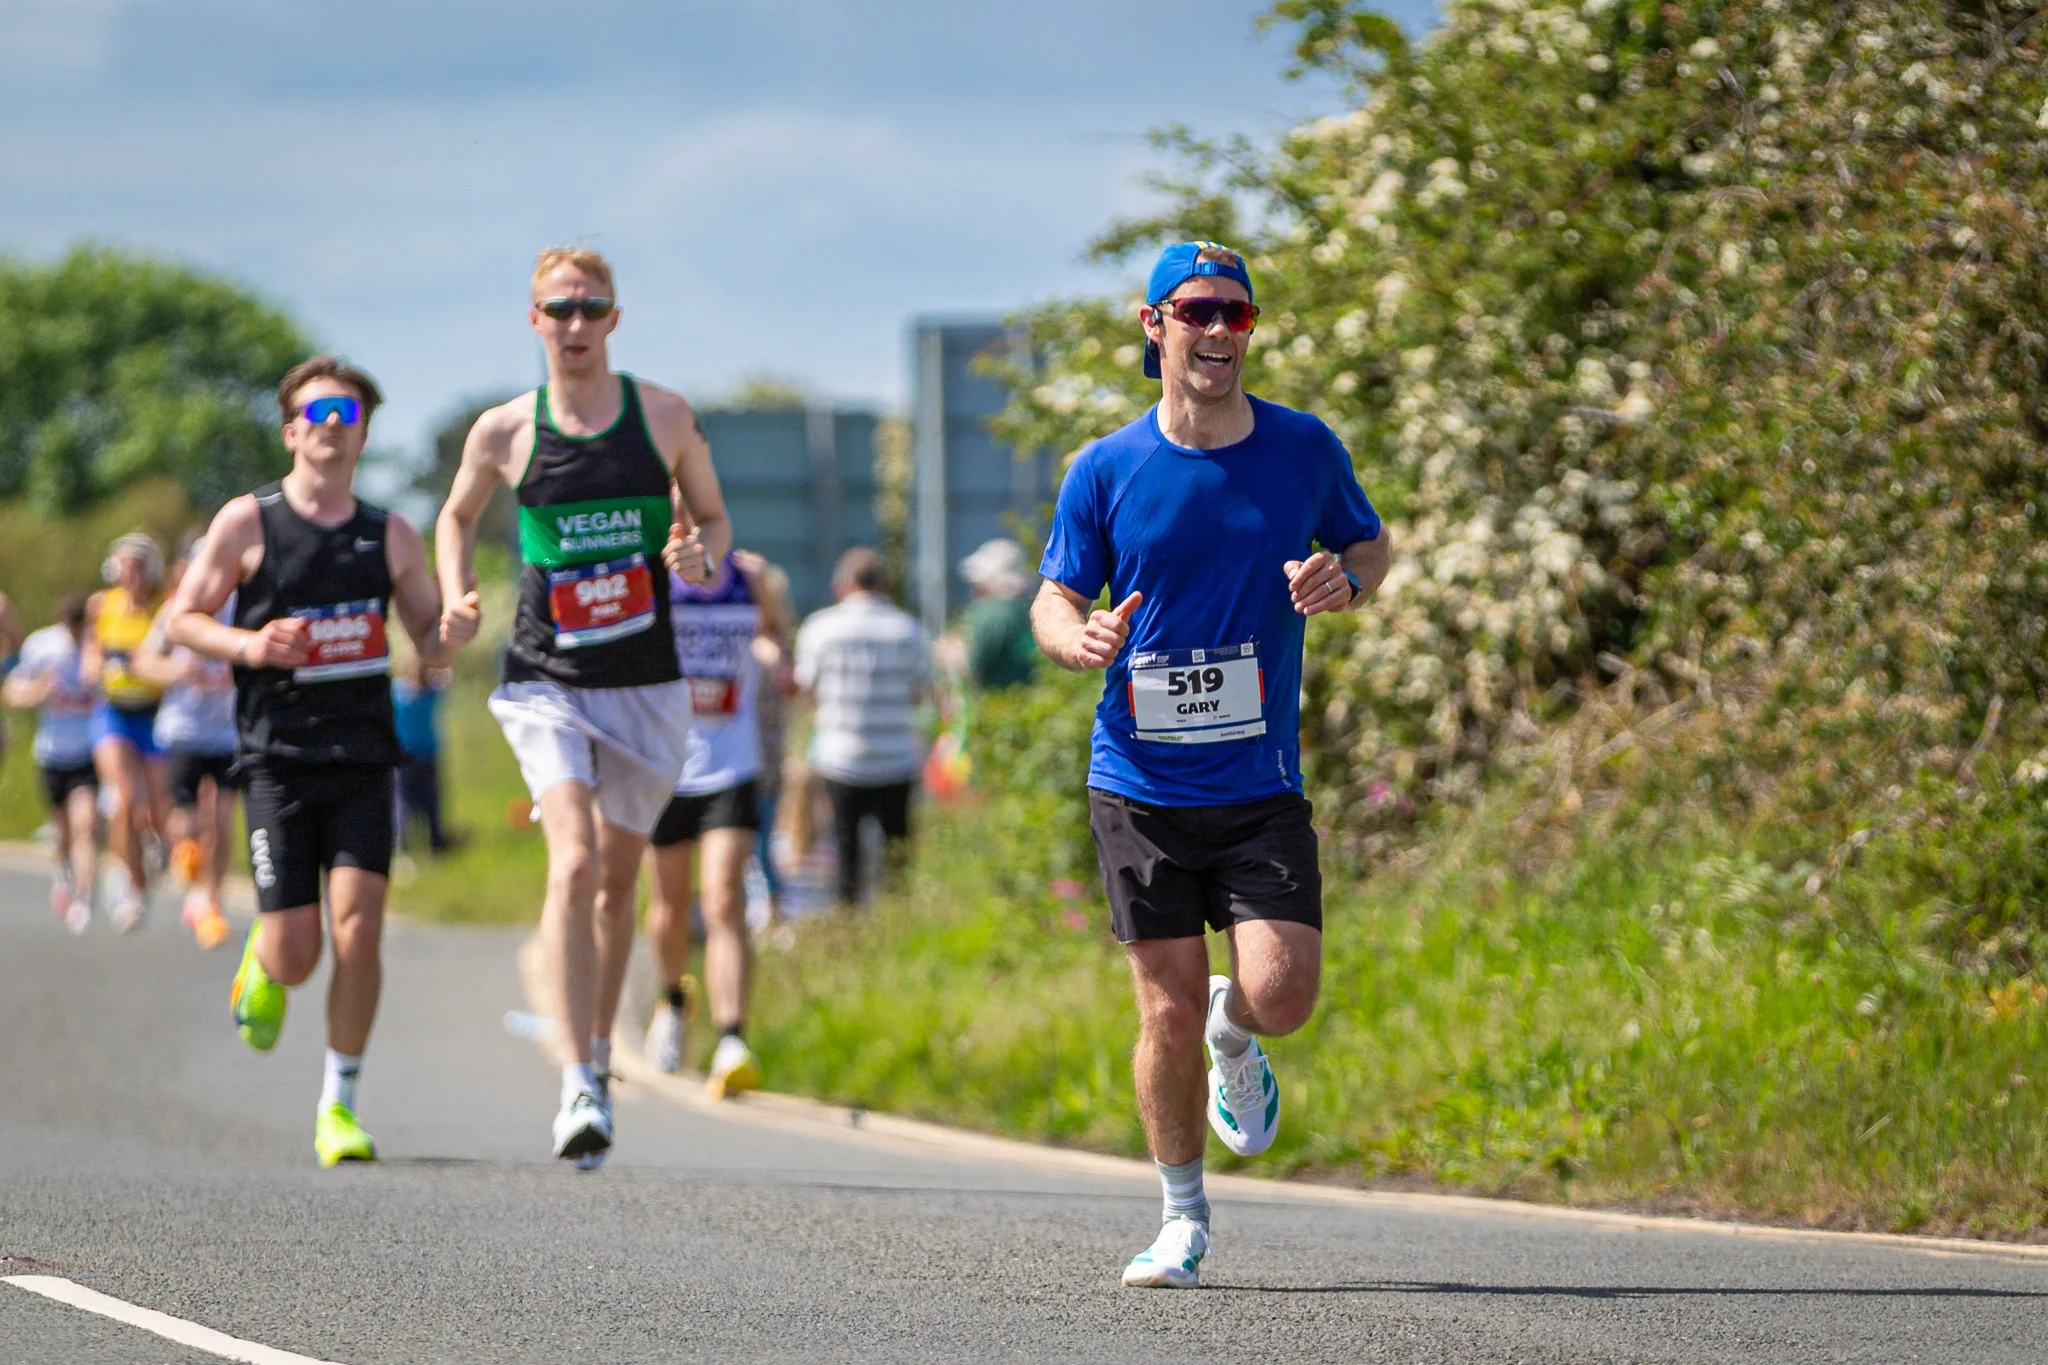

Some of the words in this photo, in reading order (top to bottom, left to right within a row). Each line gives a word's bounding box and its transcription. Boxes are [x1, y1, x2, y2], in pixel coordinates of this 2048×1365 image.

[556, 509, 641, 535] VEGAN
[560, 530, 643, 552] RUNNERS
[575, 575, 629, 607] 902
[1168, 667, 1224, 696] 519
[1177, 699, 1220, 715] GARY
